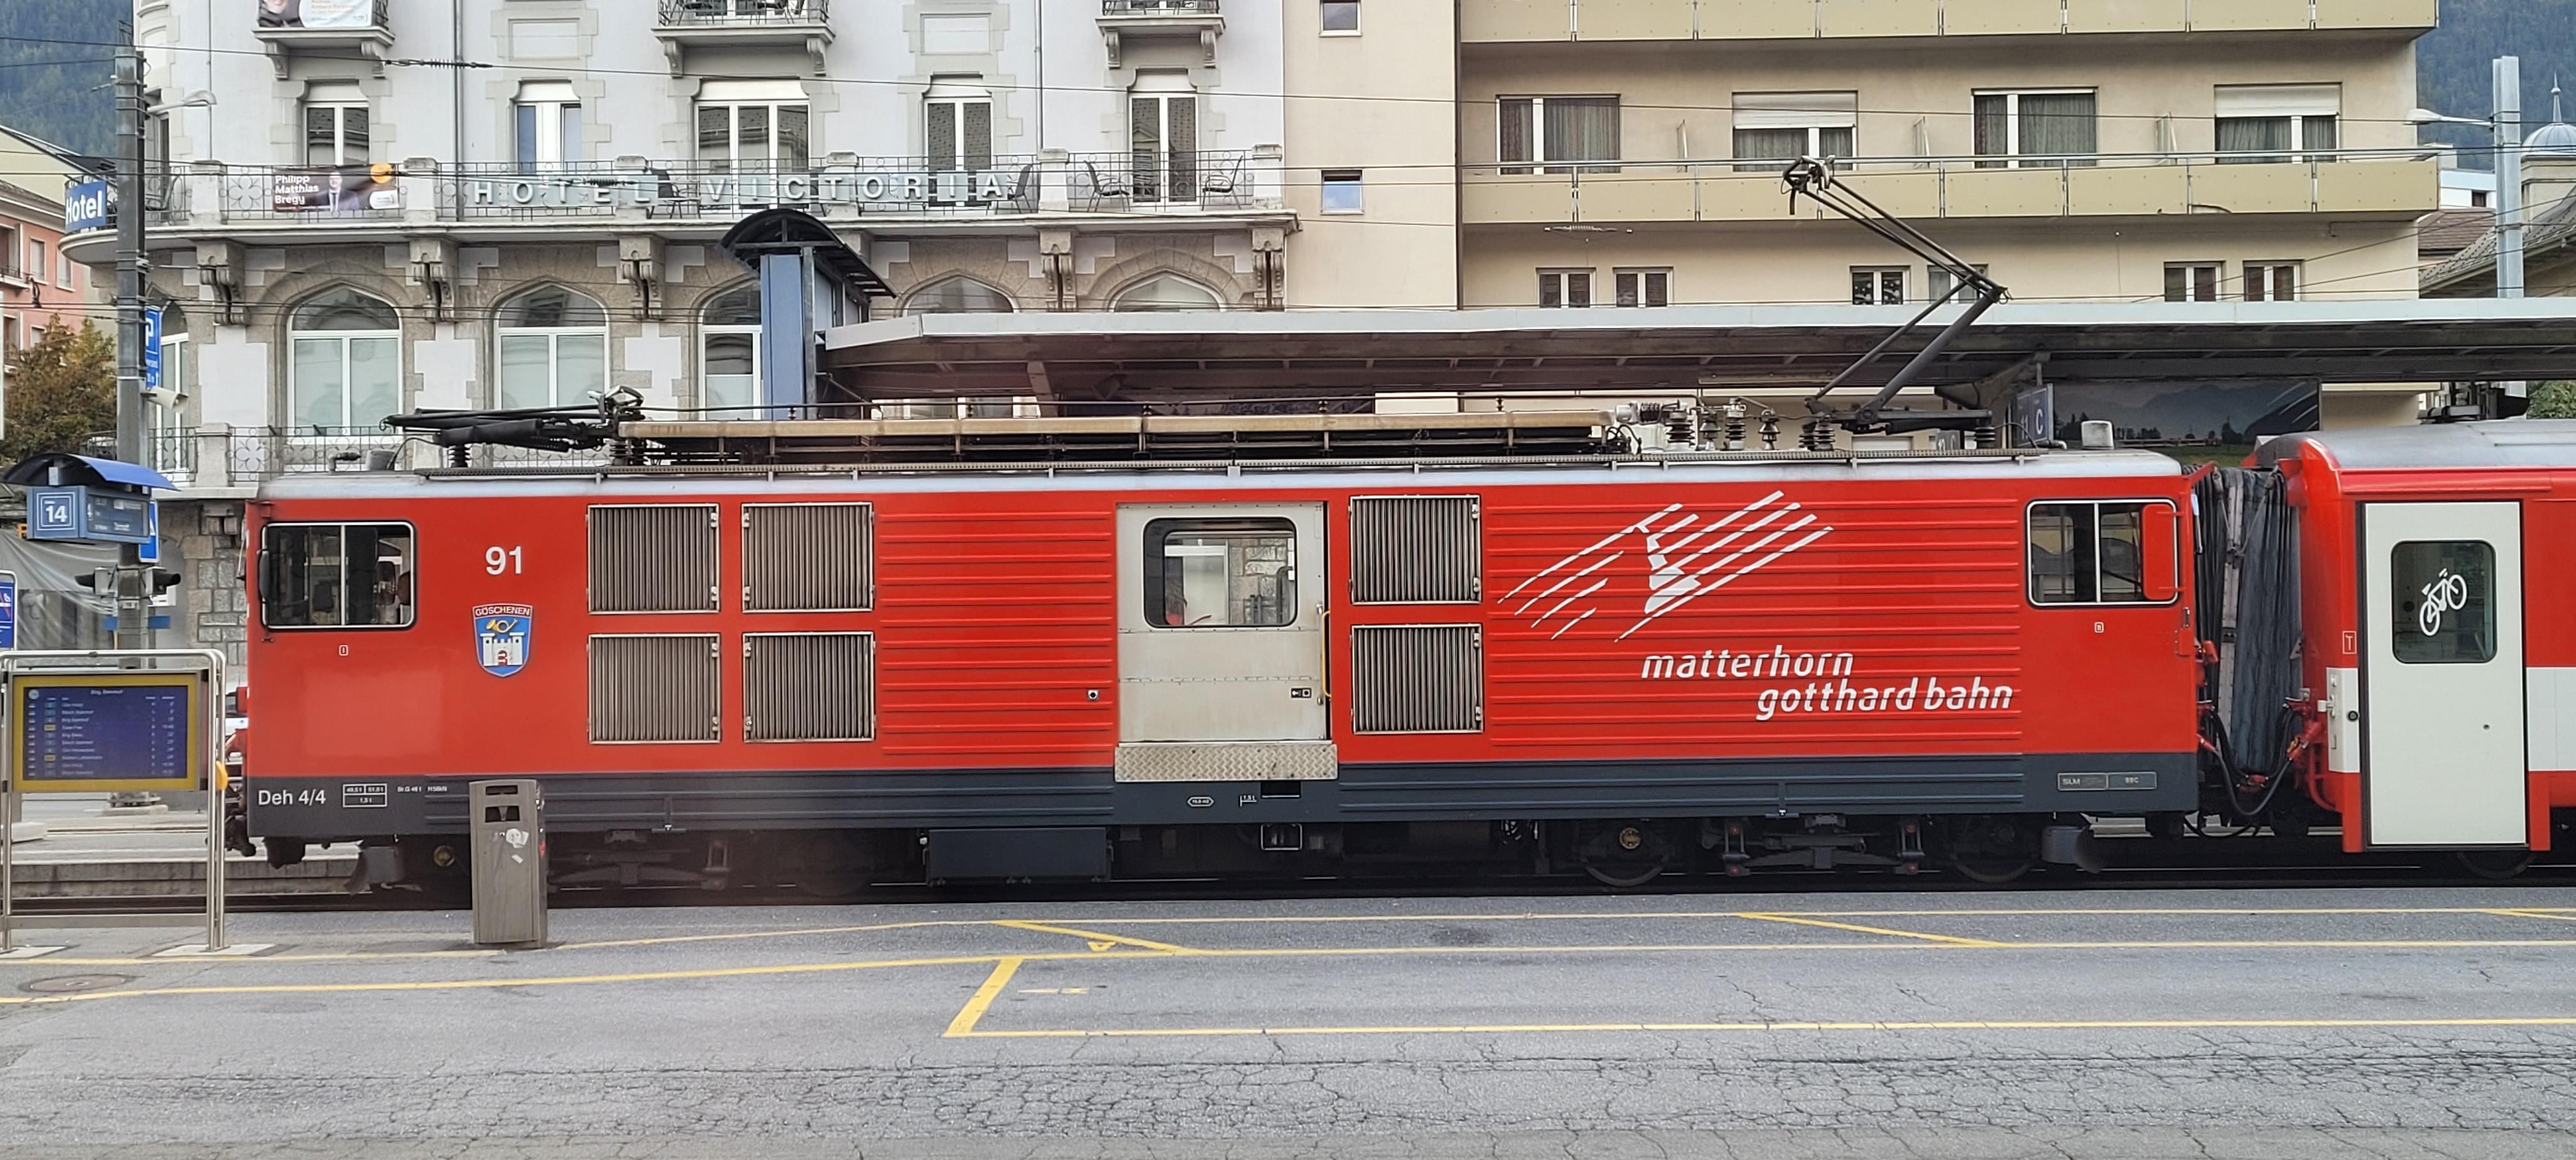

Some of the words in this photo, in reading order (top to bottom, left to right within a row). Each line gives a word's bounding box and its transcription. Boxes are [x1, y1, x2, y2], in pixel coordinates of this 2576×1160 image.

[275, 175, 310, 185] Philipp
[275, 183, 319, 194] Matthias
[474, 181, 651, 204] HOTEL
[706, 174, 1002, 202] VICTORIA
[66, 190, 102, 225] Hotel
[275, 194, 305, 205] Bregy
[2036, 409, 2043, 434] C
[46, 505, 68, 523] 14
[486, 546, 521, 575] 91
[475, 606, 530, 616] GÖSCHENEN
[1641, 645, 1853, 679] matterhorn
[1756, 678, 1919, 721] gotthard
[1924, 676, 2013, 710] bahn
[258, 790, 293, 805] Deh
[298, 790, 326, 806] 4/4
